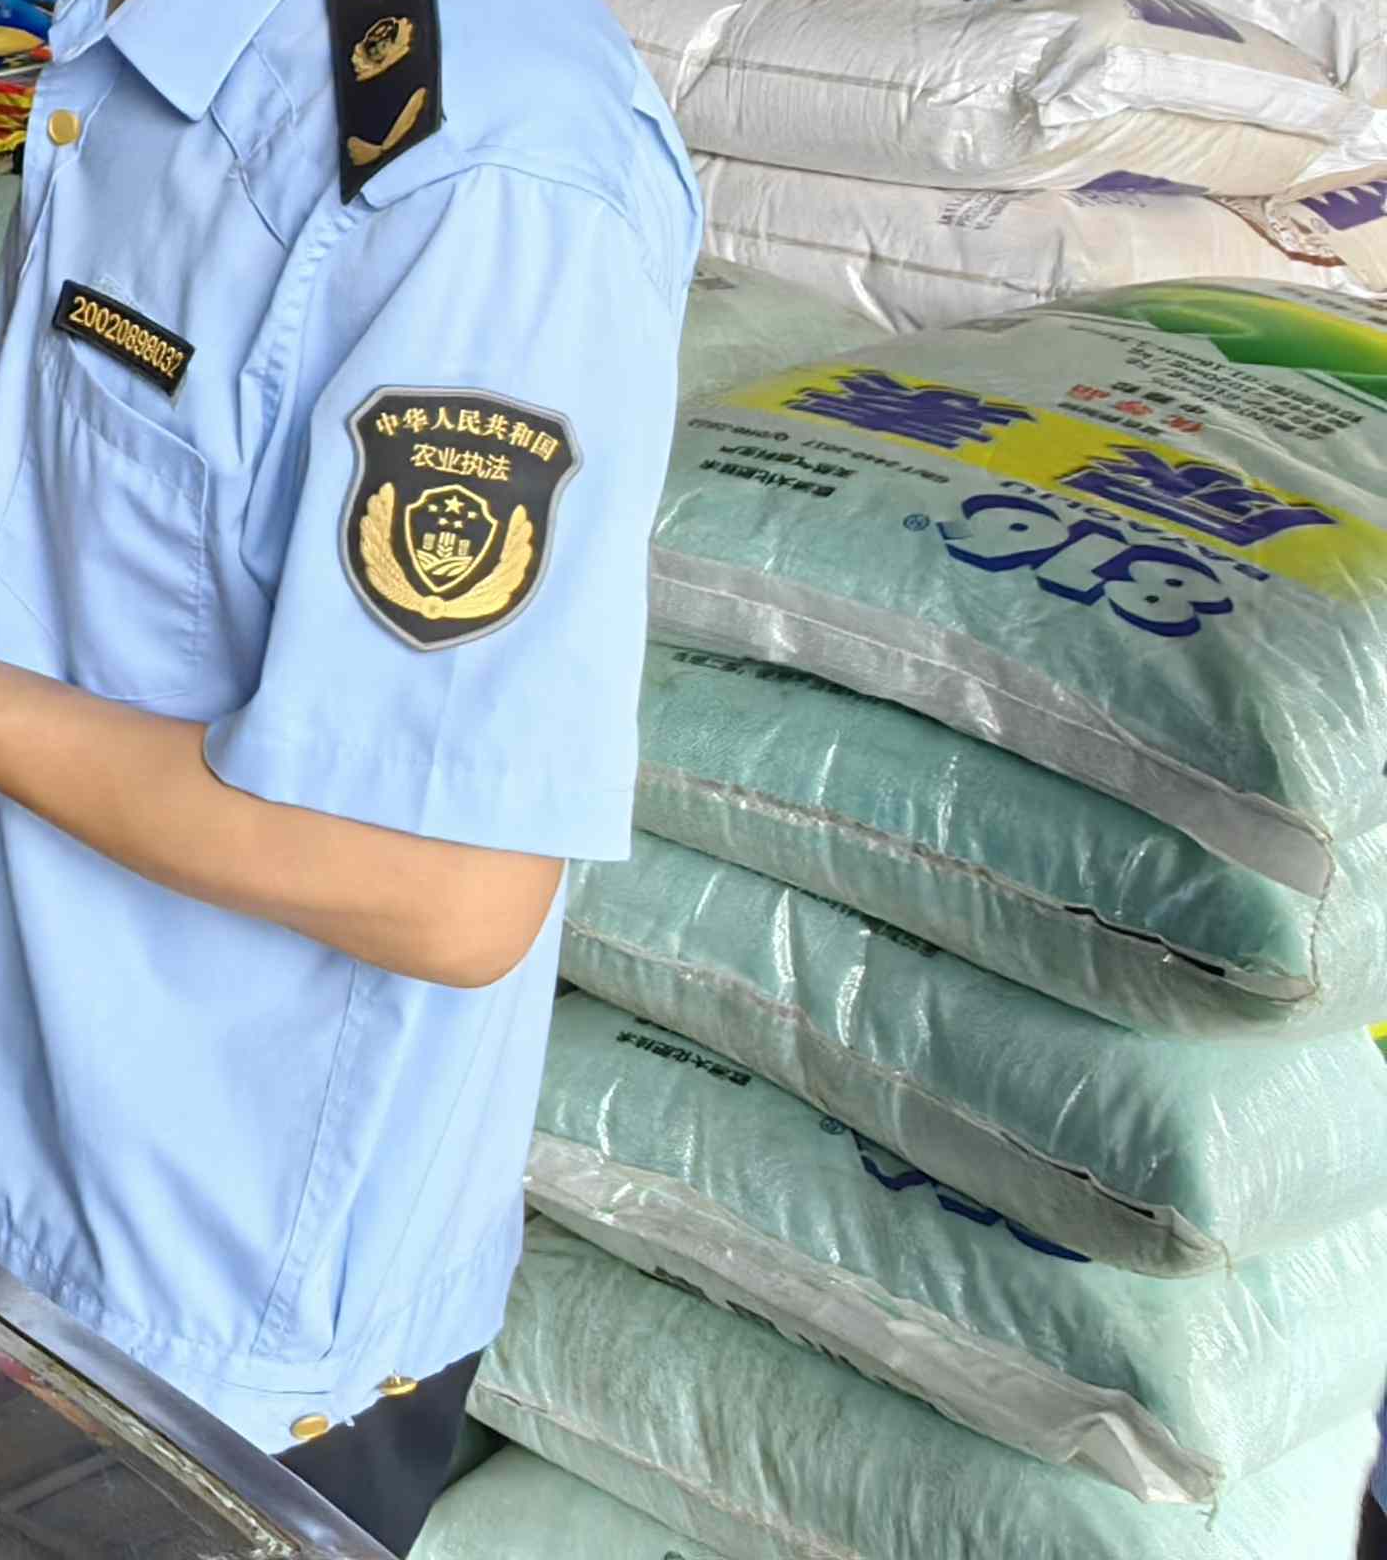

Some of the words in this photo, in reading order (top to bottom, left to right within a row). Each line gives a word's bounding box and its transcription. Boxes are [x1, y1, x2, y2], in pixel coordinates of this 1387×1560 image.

[375, 406, 559, 462] 中华人民共和国
[409, 442, 513, 482] 农业执法
